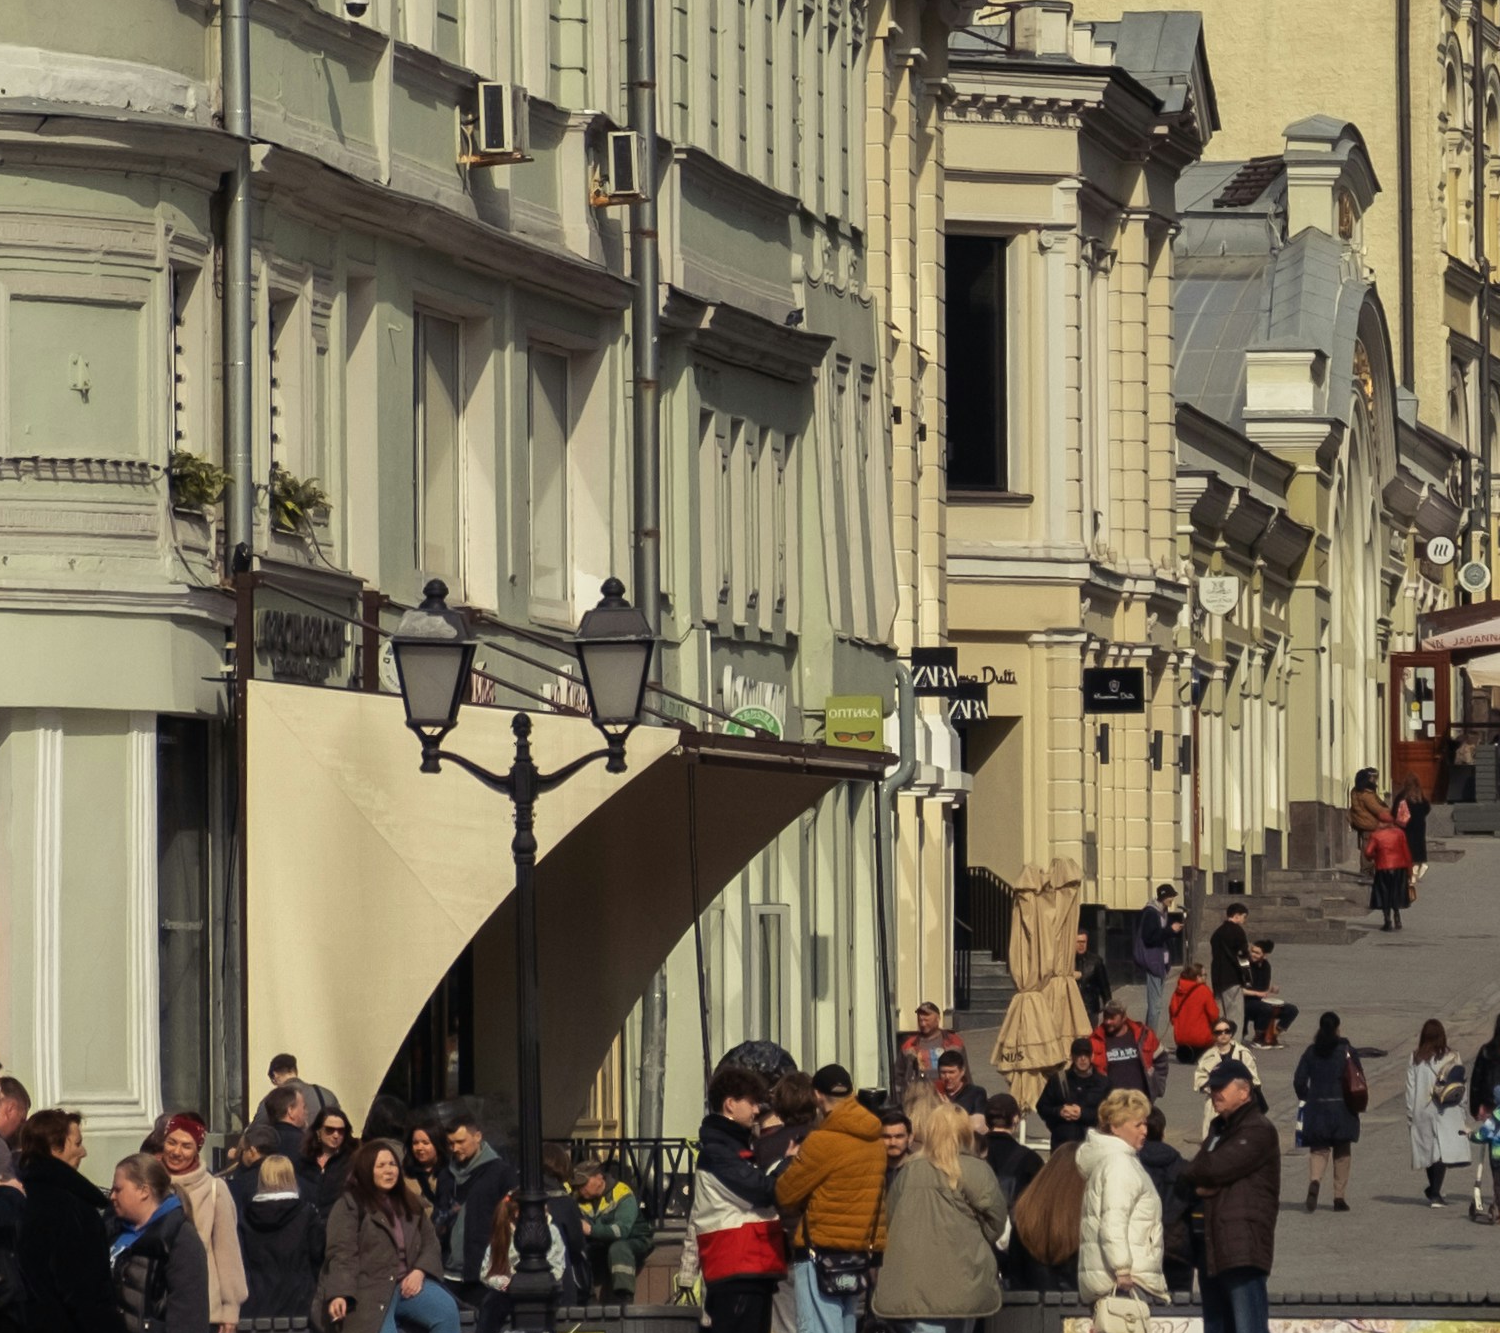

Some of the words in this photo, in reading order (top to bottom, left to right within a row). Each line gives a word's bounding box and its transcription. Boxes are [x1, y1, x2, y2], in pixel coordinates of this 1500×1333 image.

[911, 666, 957, 687] ZARA
[828, 708, 879, 719] ОПТИКА
[948, 699, 988, 720] ZARA
